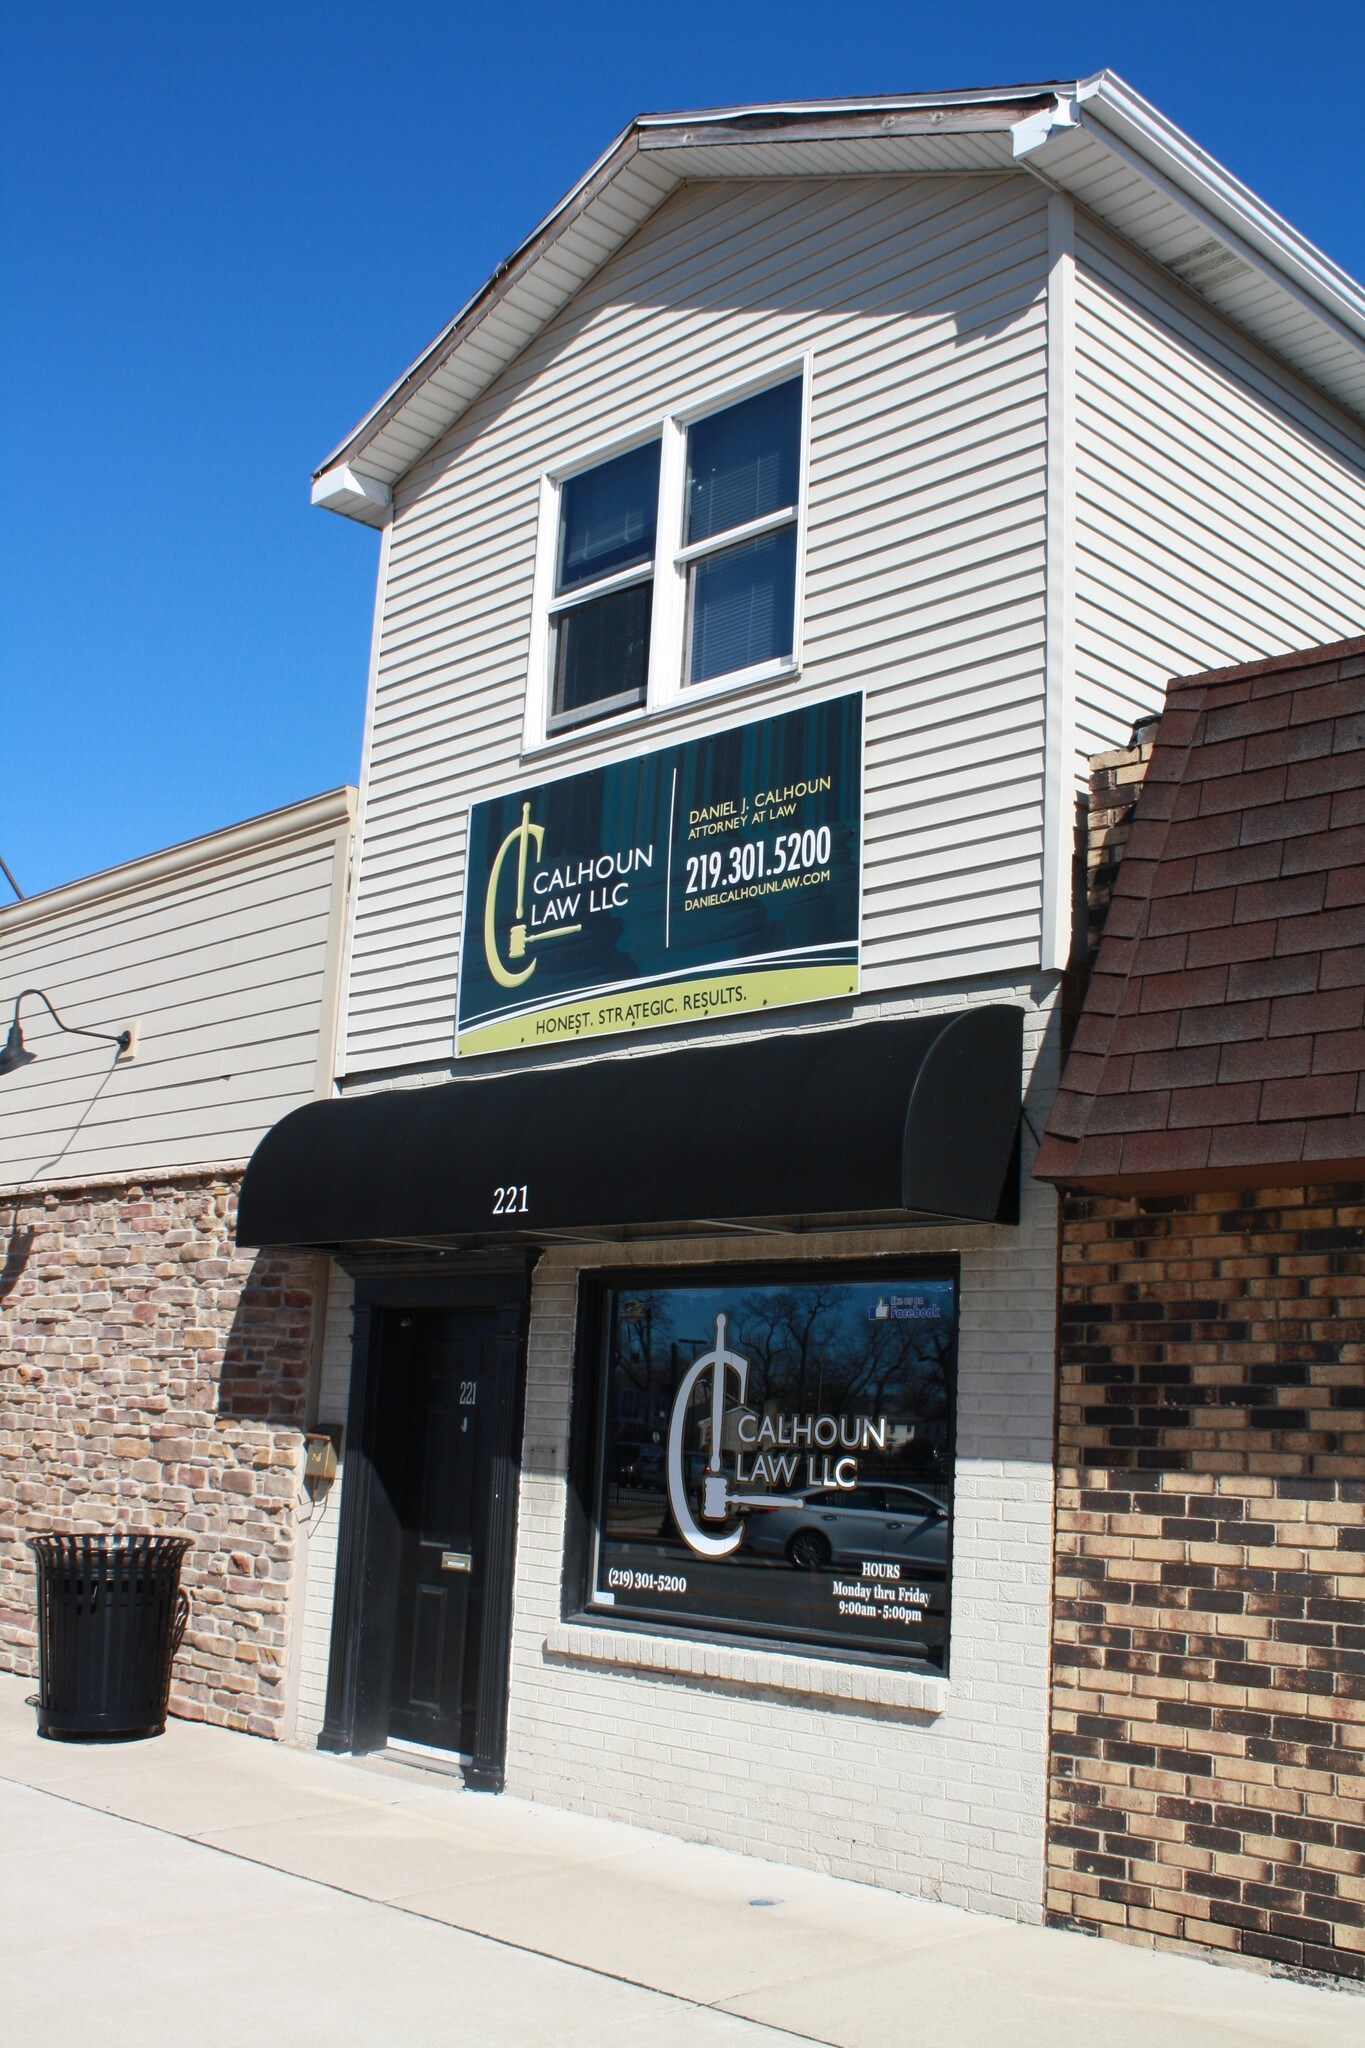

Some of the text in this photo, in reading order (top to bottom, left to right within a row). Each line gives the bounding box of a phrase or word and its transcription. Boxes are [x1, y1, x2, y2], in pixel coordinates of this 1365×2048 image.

[689, 776, 831, 824] DANIEL J. CALHOUN
[688, 803, 796, 840] ATTORNEY AT LAW
[533, 845, 653, 894] CALHOUN
[685, 826, 831, 894] 219.301.5200
[531, 883, 628, 926] LAW LLC
[685, 870, 830, 911] DANIELCALHOUNLAW.COM
[536, 986, 747, 1035] HONEST. STRATEGIC. RESULTS.
[492, 1185, 529, 1215] 221
[891, 1305, 940, 1318] Facebook
[459, 1381, 477, 1405] 221
[738, 1414, 885, 1447] CALHOUN
[736, 1453, 856, 1488] LAW LLC
[609, 1568, 687, 1592] (219) 301-5200
[862, 1562, 900, 1578] HOURS
[833, 1581, 931, 1607] Monday thru Friday
[839, 1601, 876, 1617] 9:00am
[882, 1605, 922, 1624] 5:00pm
